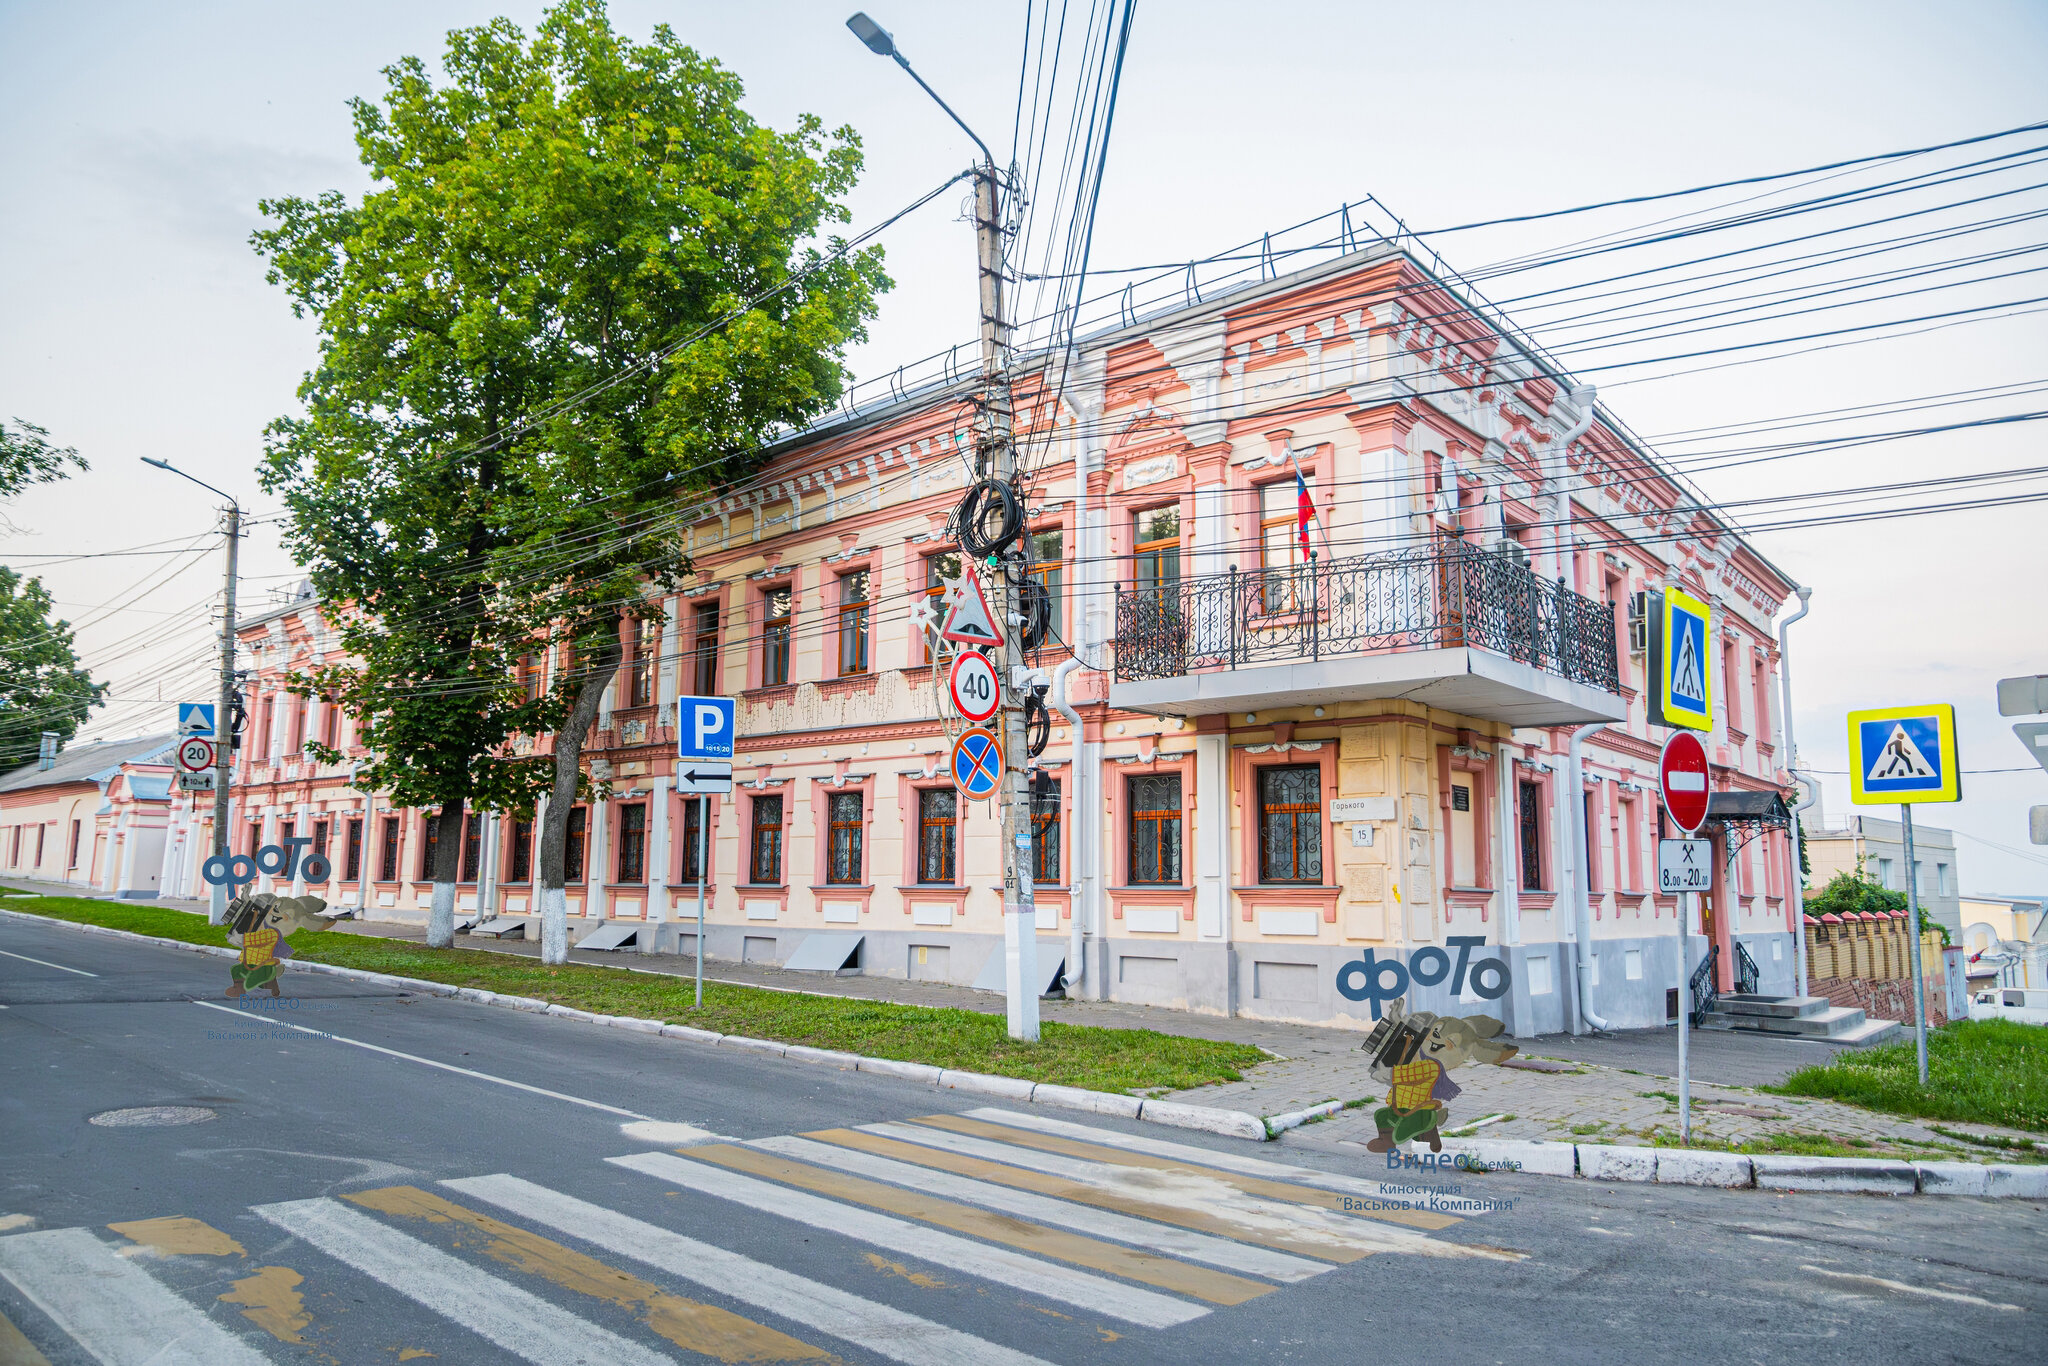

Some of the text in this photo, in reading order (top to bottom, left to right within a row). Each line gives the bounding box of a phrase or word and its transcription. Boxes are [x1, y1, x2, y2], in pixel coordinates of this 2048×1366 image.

[962, 672, 990, 701] 40
[695, 704, 725, 750] P
[187, 747, 206, 760] 20
[1332, 801, 1365, 811] Горького
[1358, 829, 1367, 840] 15
